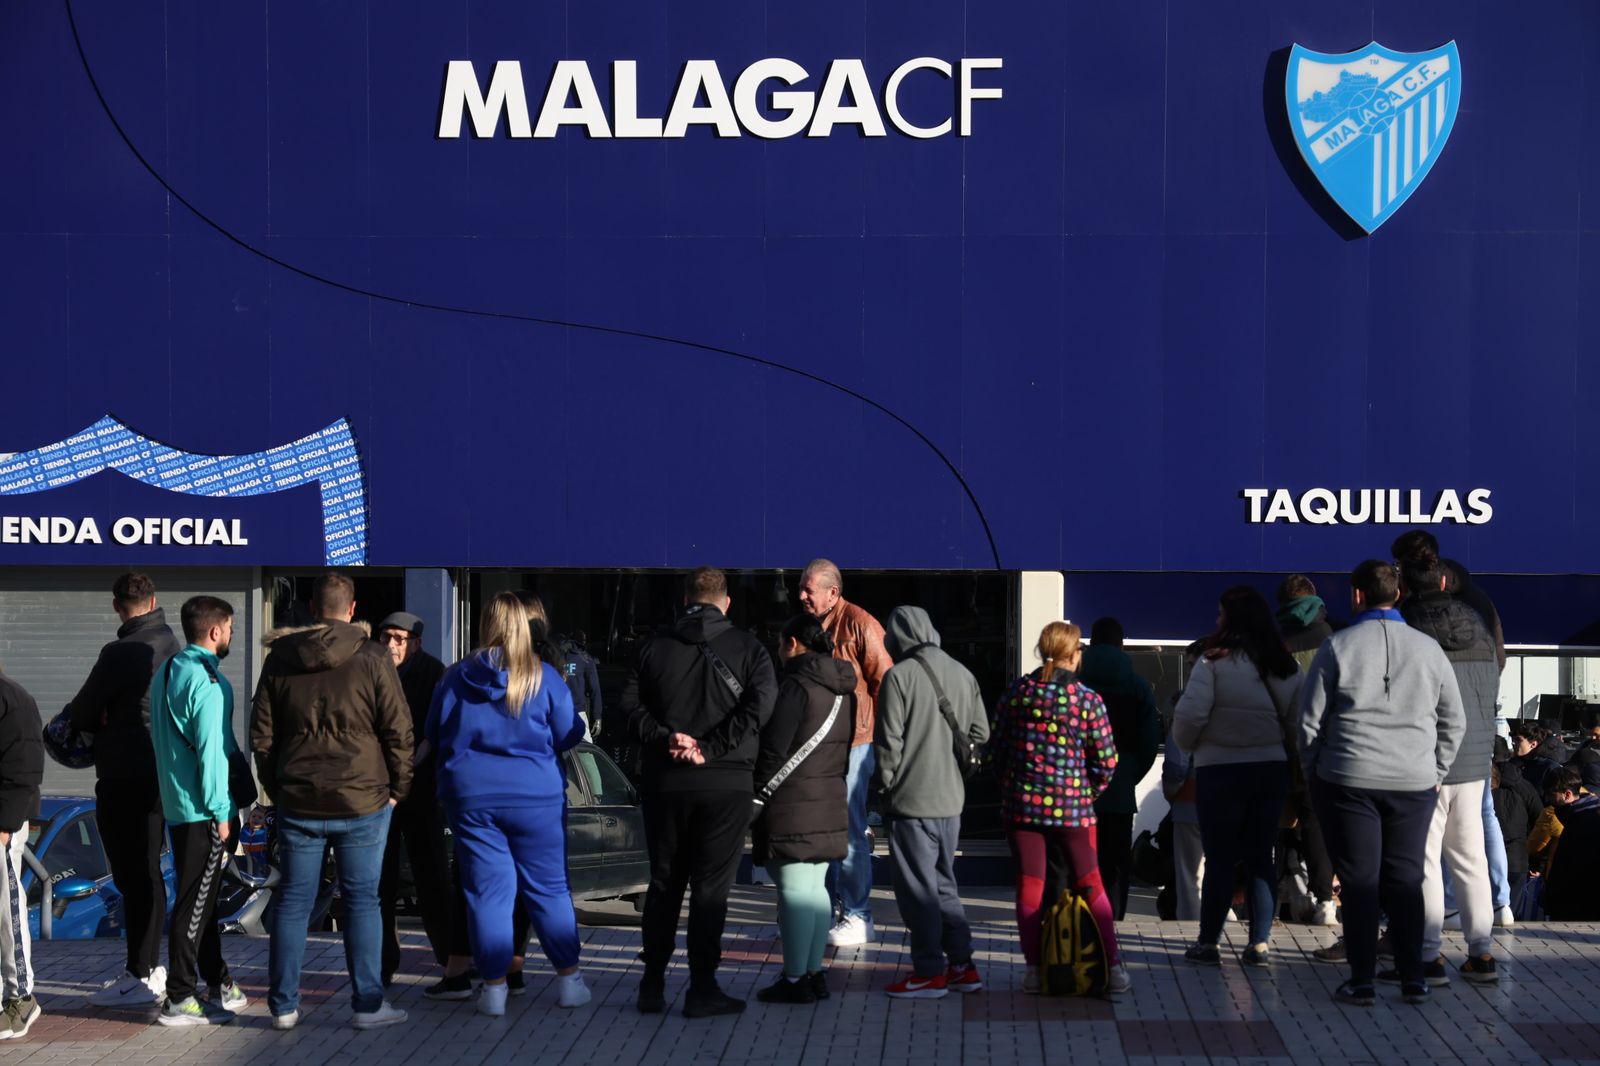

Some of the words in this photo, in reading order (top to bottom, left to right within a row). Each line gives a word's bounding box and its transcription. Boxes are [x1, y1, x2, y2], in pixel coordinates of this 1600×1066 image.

[38, 441, 66, 454] TIENDA
[67, 432, 96, 445] OFICIAL
[43, 458, 71, 471] TIENDA
[72, 449, 101, 461] OFICIAL
[102, 439, 135, 453] MALAGA
[155, 450, 183, 463] TIENDA
[270, 458, 298, 470] TIENDA
[299, 449, 328, 461] OFICIAL
[160, 467, 188, 480] TIENDA
[189, 458, 218, 470] OFICIAL
[194, 474, 223, 486] OFICIAL
[224, 464, 257, 478] MALAGA
[275, 474, 303, 486] TIENDA
[304, 465, 333, 477] OFICIAL
[0, 478, 34, 492] MALAGA
[48, 474, 76, 487] TIENDA
[229, 480, 262, 494] MALAGA
[1244, 488, 1493, 525] TAQUILLAS
[112, 516, 248, 546] OFICIAL
[325, 528, 353, 542] OFICIAL
[331, 544, 359, 557] OFICIAL
